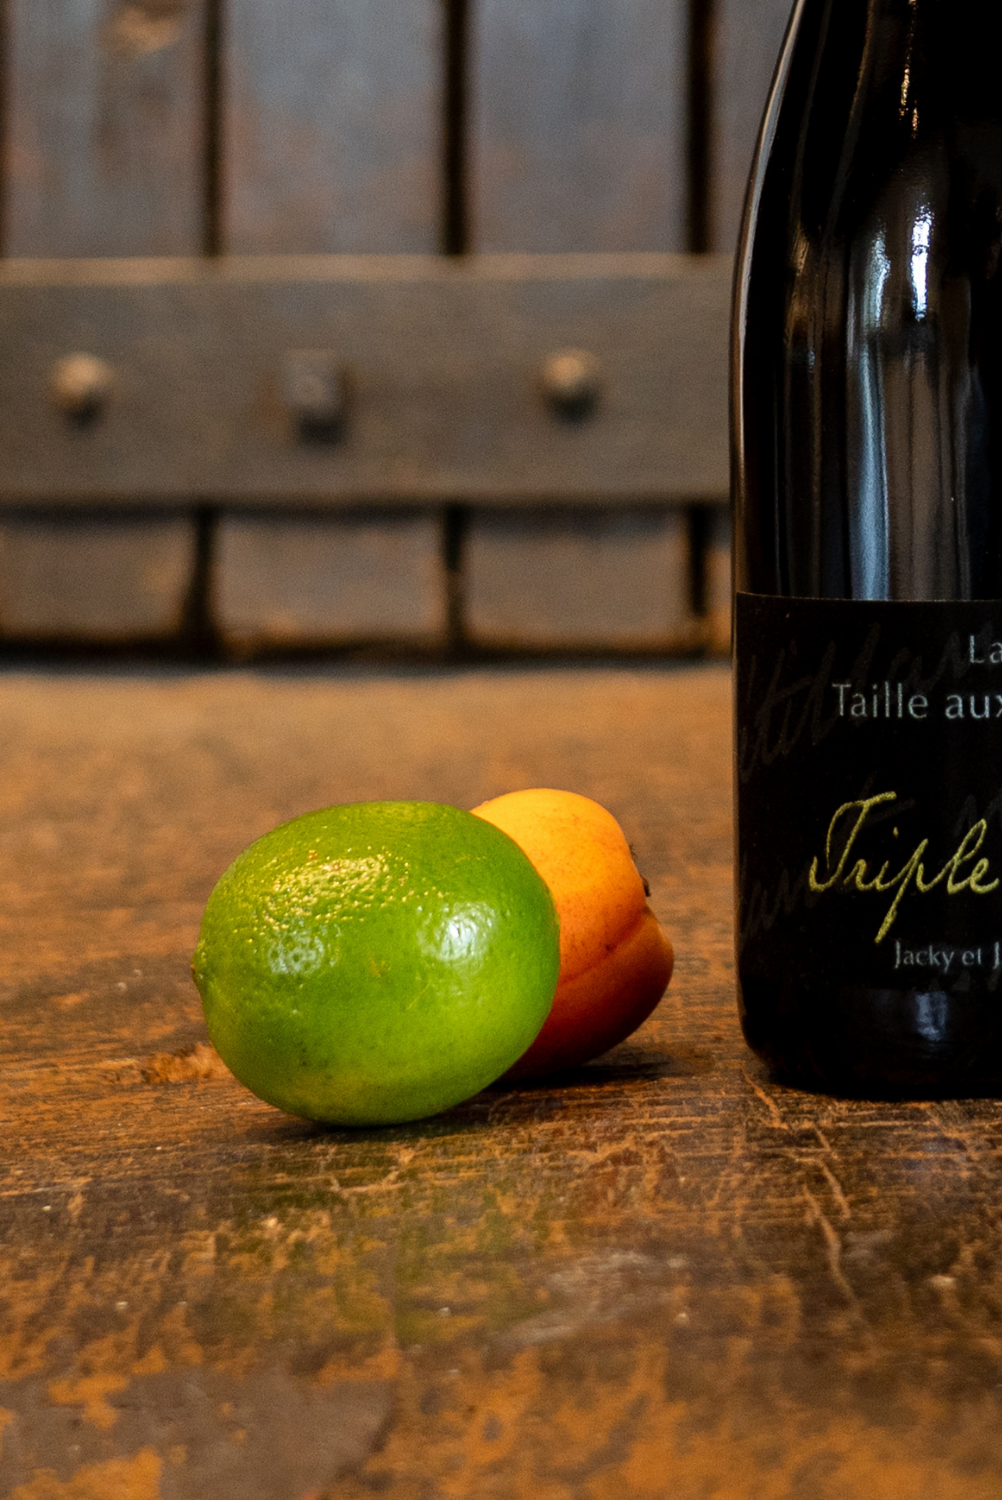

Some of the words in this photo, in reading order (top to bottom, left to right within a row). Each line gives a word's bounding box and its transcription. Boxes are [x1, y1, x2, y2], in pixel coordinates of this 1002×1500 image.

[832, 682, 929, 719] Taille
[809, 791, 1001, 943] Triple
[894, 941, 955, 974] Jacky
[961, 948, 983, 966] et
